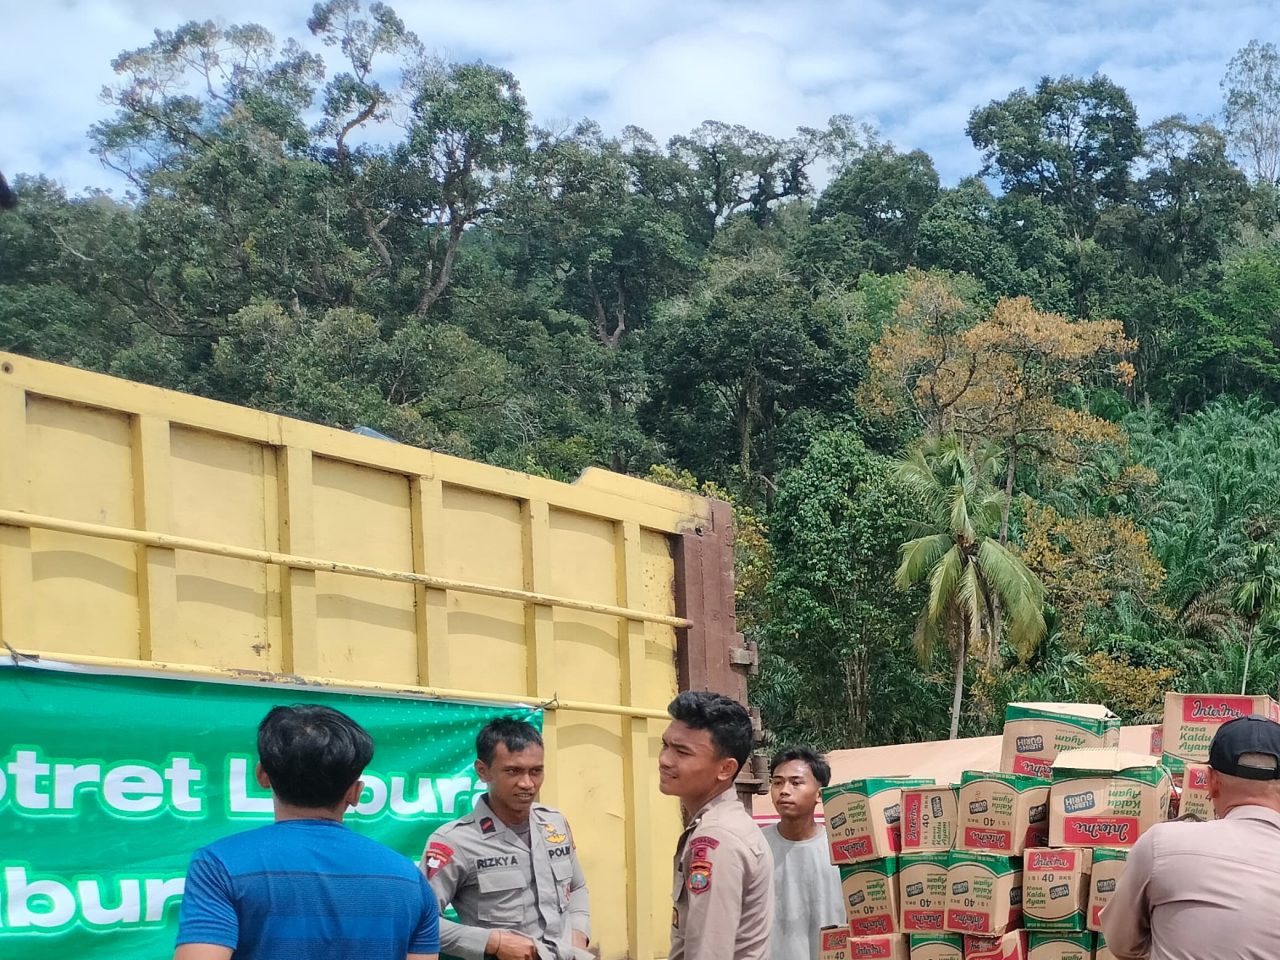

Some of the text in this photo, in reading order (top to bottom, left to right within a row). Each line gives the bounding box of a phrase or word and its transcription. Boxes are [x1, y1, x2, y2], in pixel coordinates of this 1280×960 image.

[1017, 736, 1042, 745] GURIH
[1054, 734, 1086, 745] Ayam
[1179, 733, 1211, 742] Kaldu
[1179, 742, 1211, 752] Ayam
[0, 750, 488, 816] tret Lbur
[1108, 788, 1142, 799] Ayam
[1065, 794, 1093, 804] GURIH
[1107, 800, 1142, 810] Kaldu
[922, 815, 929, 828] 40
[984, 818, 995, 826] 40
[845, 828, 855, 836] 40
[476, 856, 518, 869] RIZKY A
[1042, 874, 1054, 882] 40
[0, 866, 187, 927] bur
[920, 898, 932, 907] 40
[964, 898, 975, 906] 40
